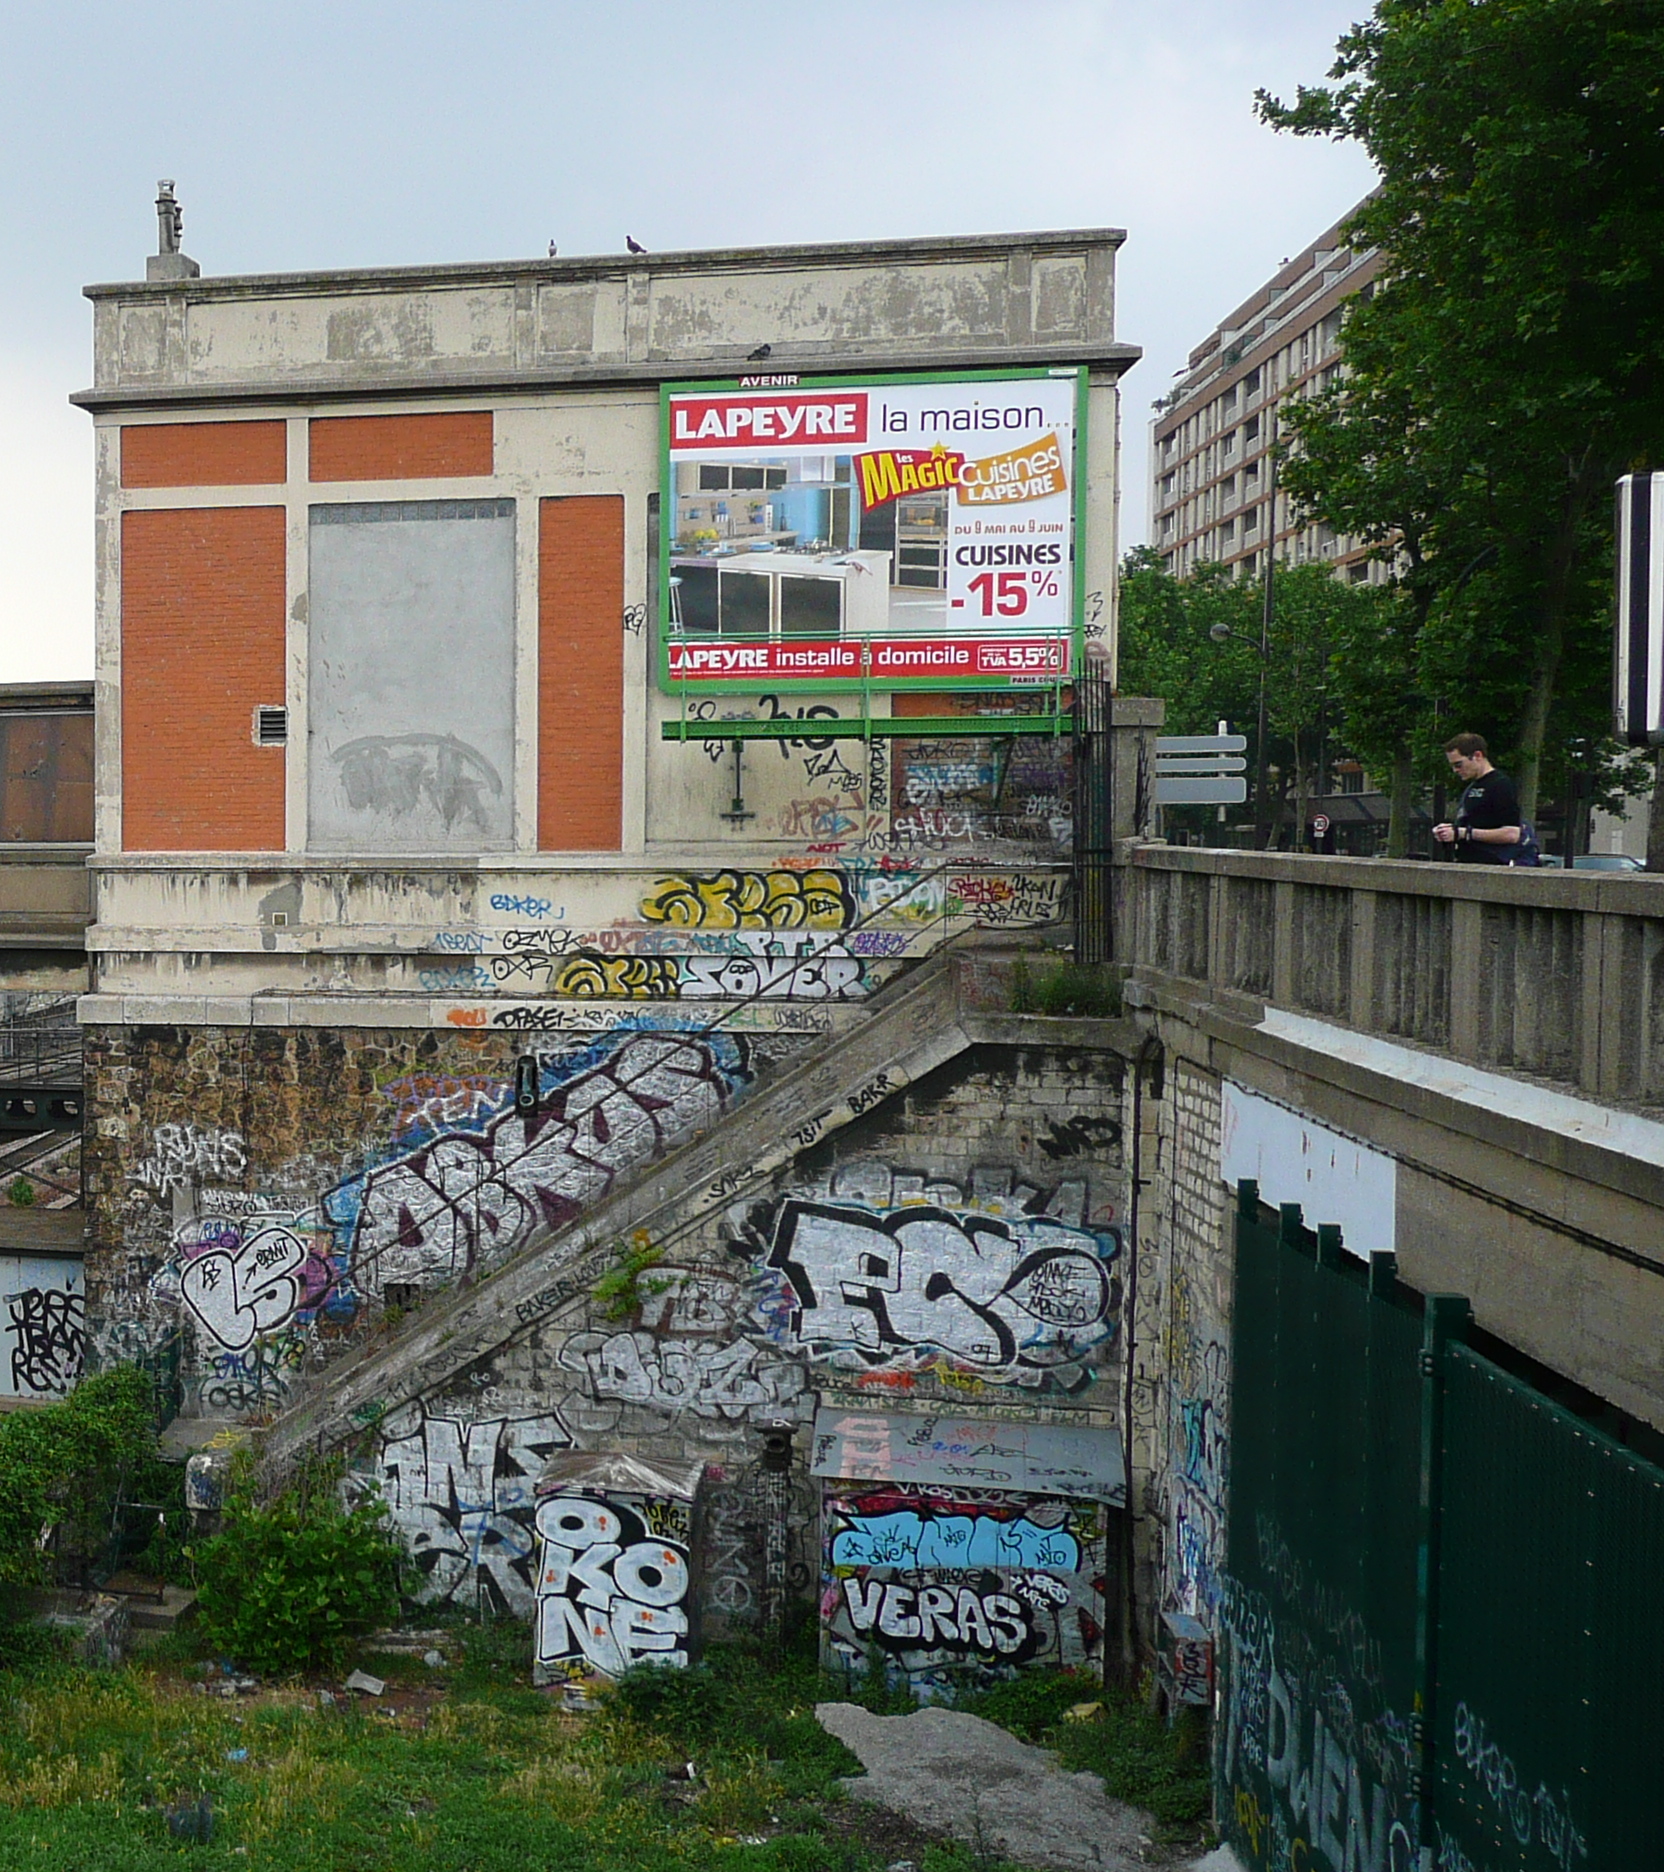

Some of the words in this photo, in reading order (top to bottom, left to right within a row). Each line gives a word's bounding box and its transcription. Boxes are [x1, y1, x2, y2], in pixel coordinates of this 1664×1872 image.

[739, 375, 799, 387] AVENIR
[675, 403, 857, 439] LAPEYRE
[881, 403, 908, 432] la
[957, 446, 1061, 487] Cuisines
[967, 474, 1056, 501] LAPEYRE
[954, 525, 972, 535] DU
[974, 520, 982, 534] 9
[984, 524, 1006, 534] MAI
[1009, 524, 1026, 534] AU
[1028, 519, 1036, 533] 9
[1037, 523, 1064, 534] JUIN
[955, 543, 1062, 567] CUISINES
[775, 647, 855, 666] installe
[878, 645, 970, 666] domicile
[981, 656, 1007, 667] TVA
[841, 1576, 1029, 1655] VERAS
